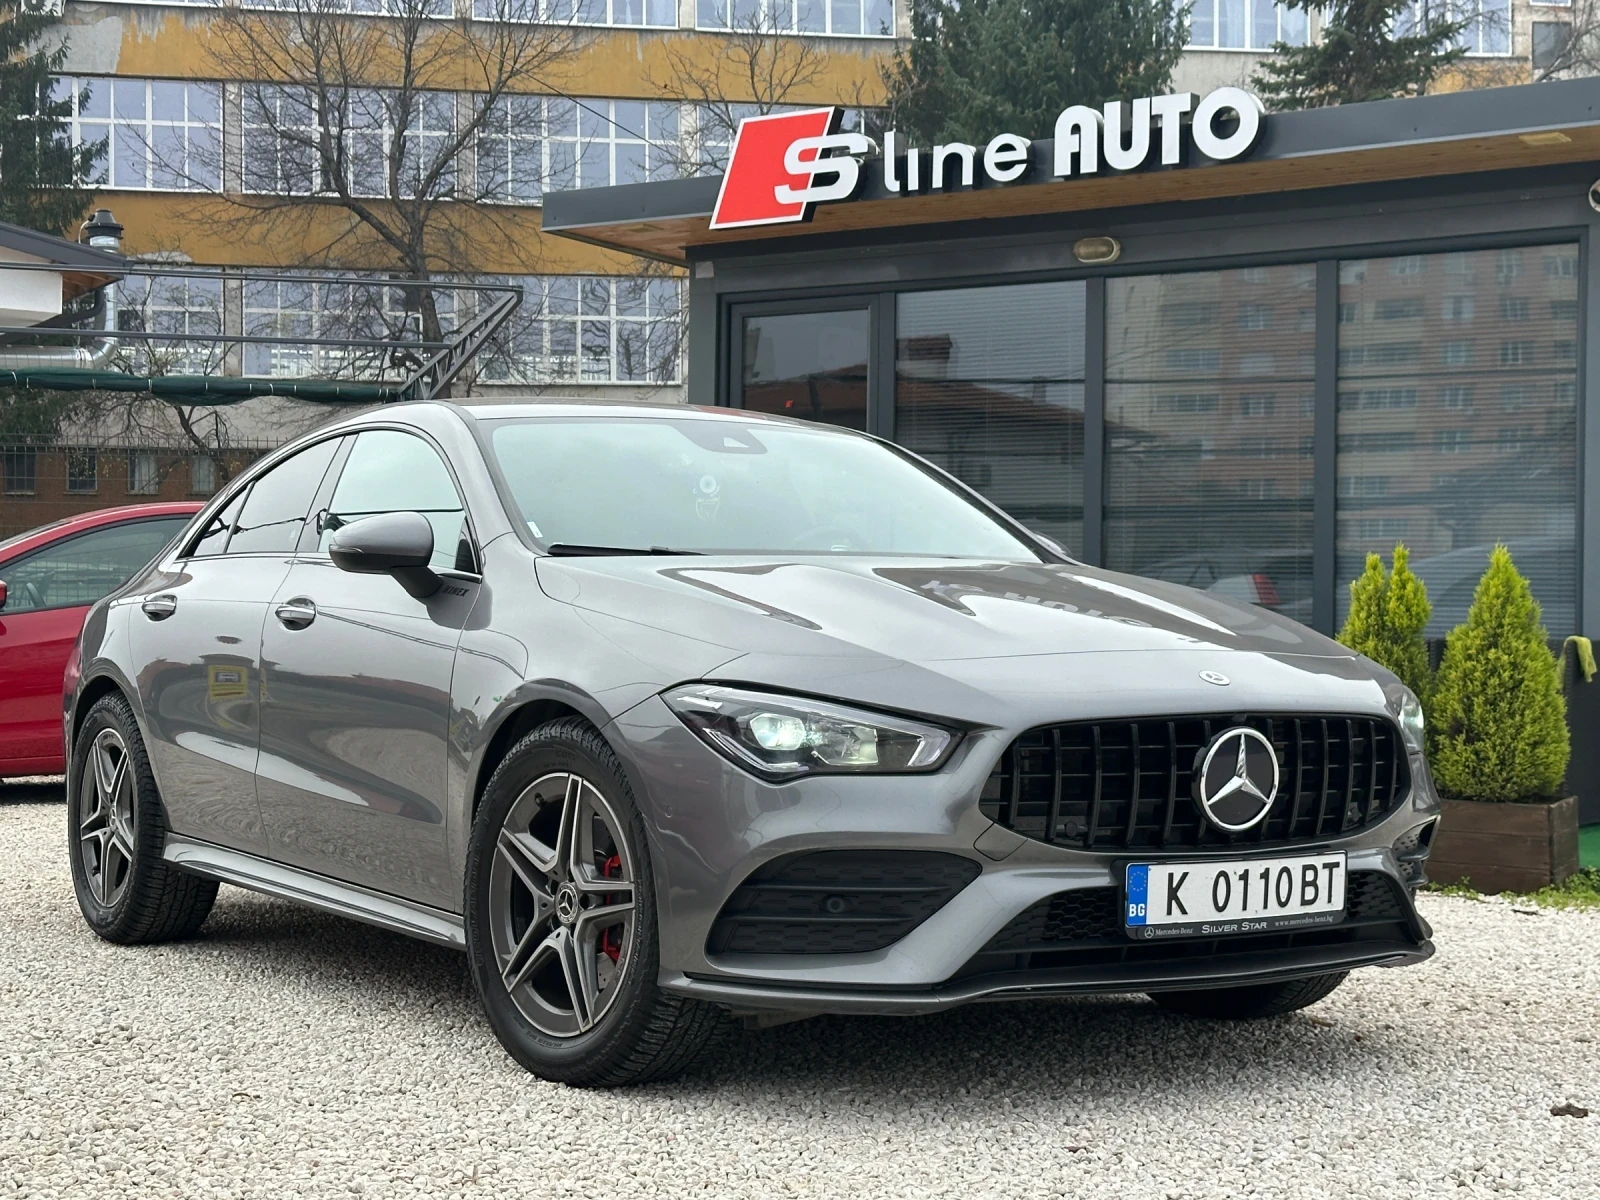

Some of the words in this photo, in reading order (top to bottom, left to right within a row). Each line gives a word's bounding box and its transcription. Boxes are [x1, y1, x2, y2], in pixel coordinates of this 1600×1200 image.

[884, 131, 1029, 193] line
[1054, 86, 1260, 177] AUTO
[1129, 903, 1146, 917] BG
[1166, 871, 1190, 916] K
[1212, 861, 1341, 913] 0110BT
